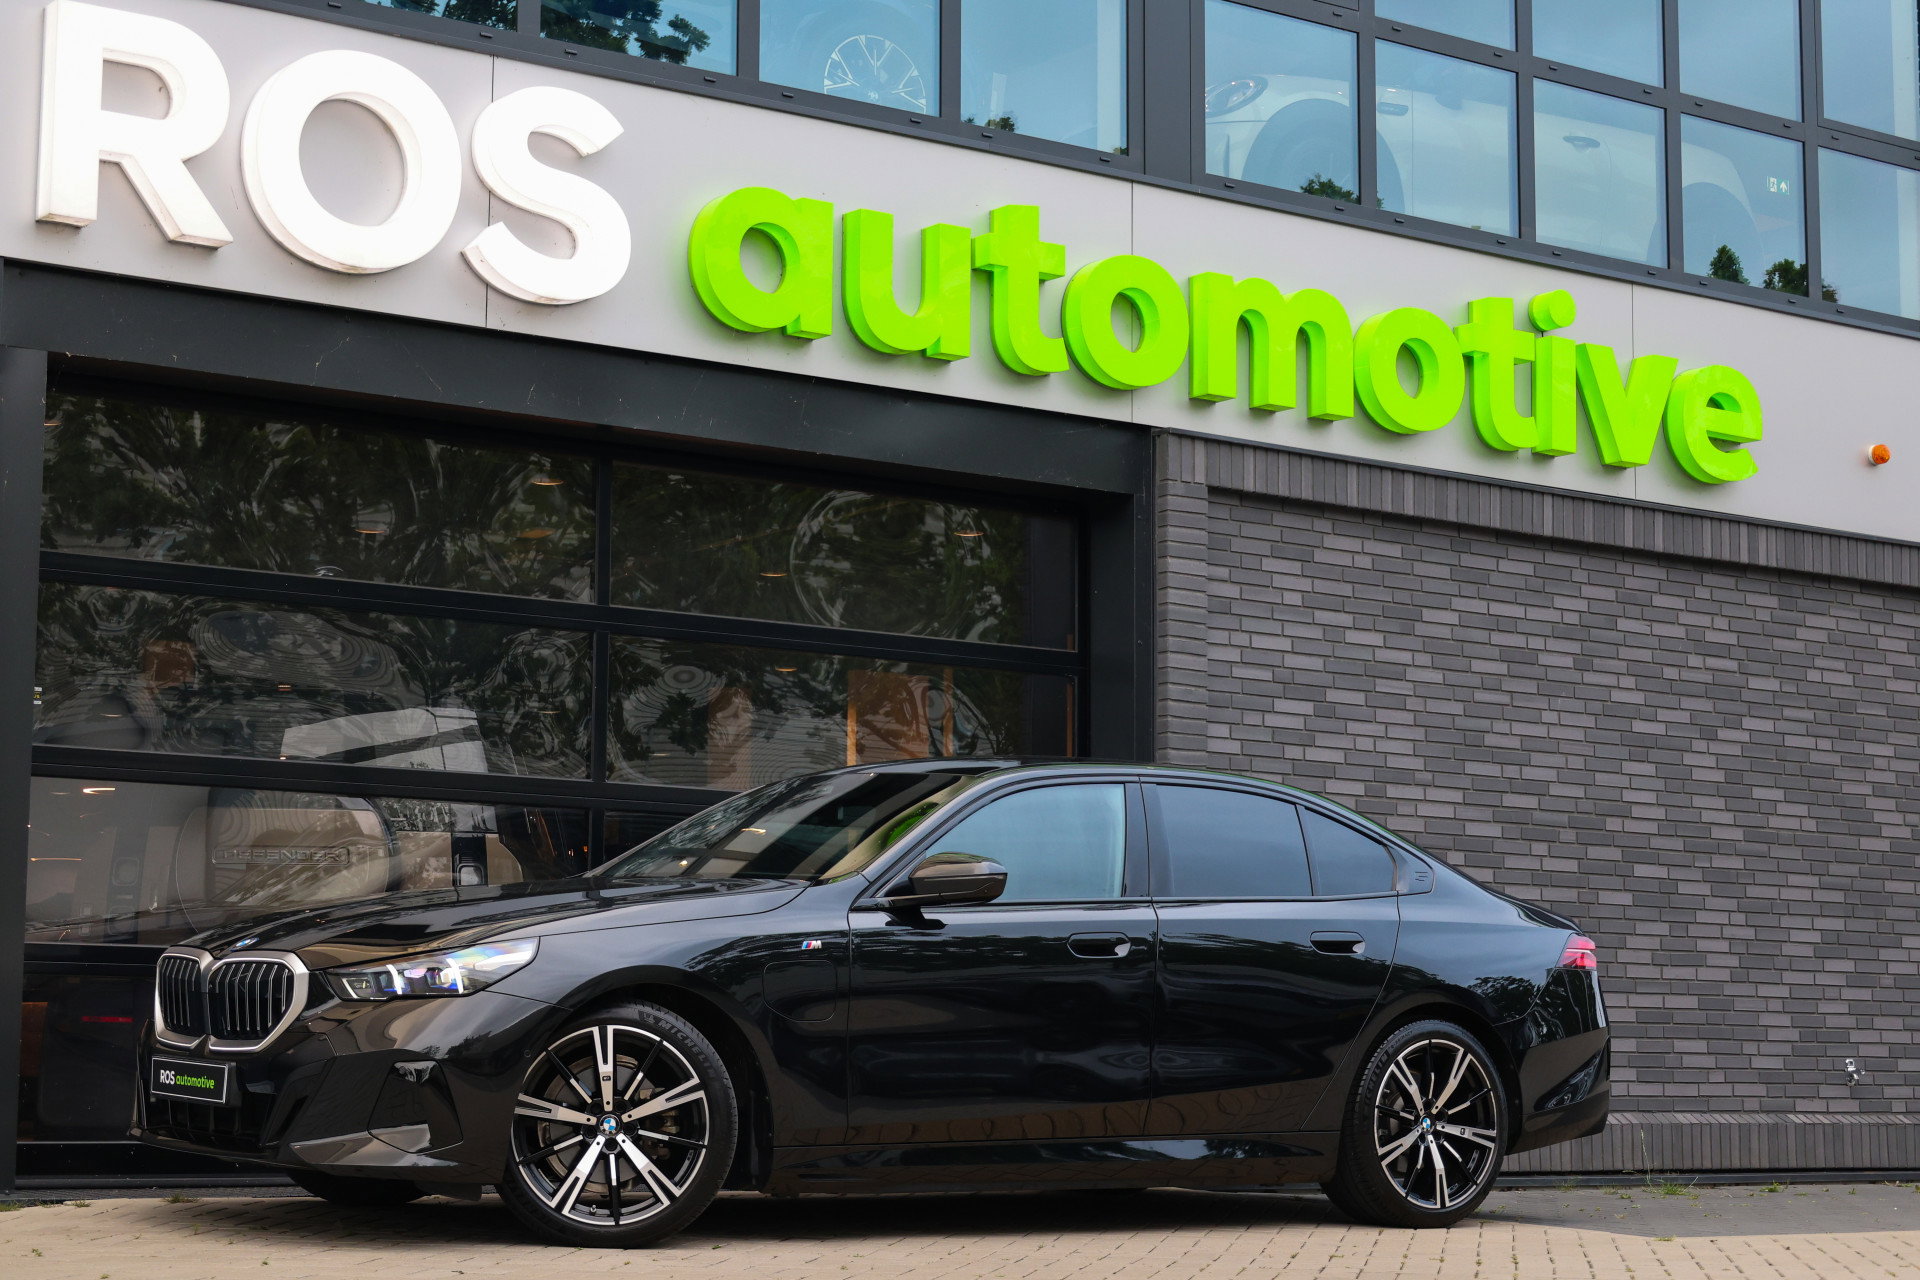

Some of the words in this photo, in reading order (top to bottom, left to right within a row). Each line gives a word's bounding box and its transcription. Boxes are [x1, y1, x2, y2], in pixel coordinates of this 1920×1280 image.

[36, 0, 631, 306] ROS
[688, 186, 1763, 484] automotive
[657, 1018, 717, 1077] MICHELIN
[160, 1069, 175, 1085] ROS
[175, 1074, 215, 1089] automotive
